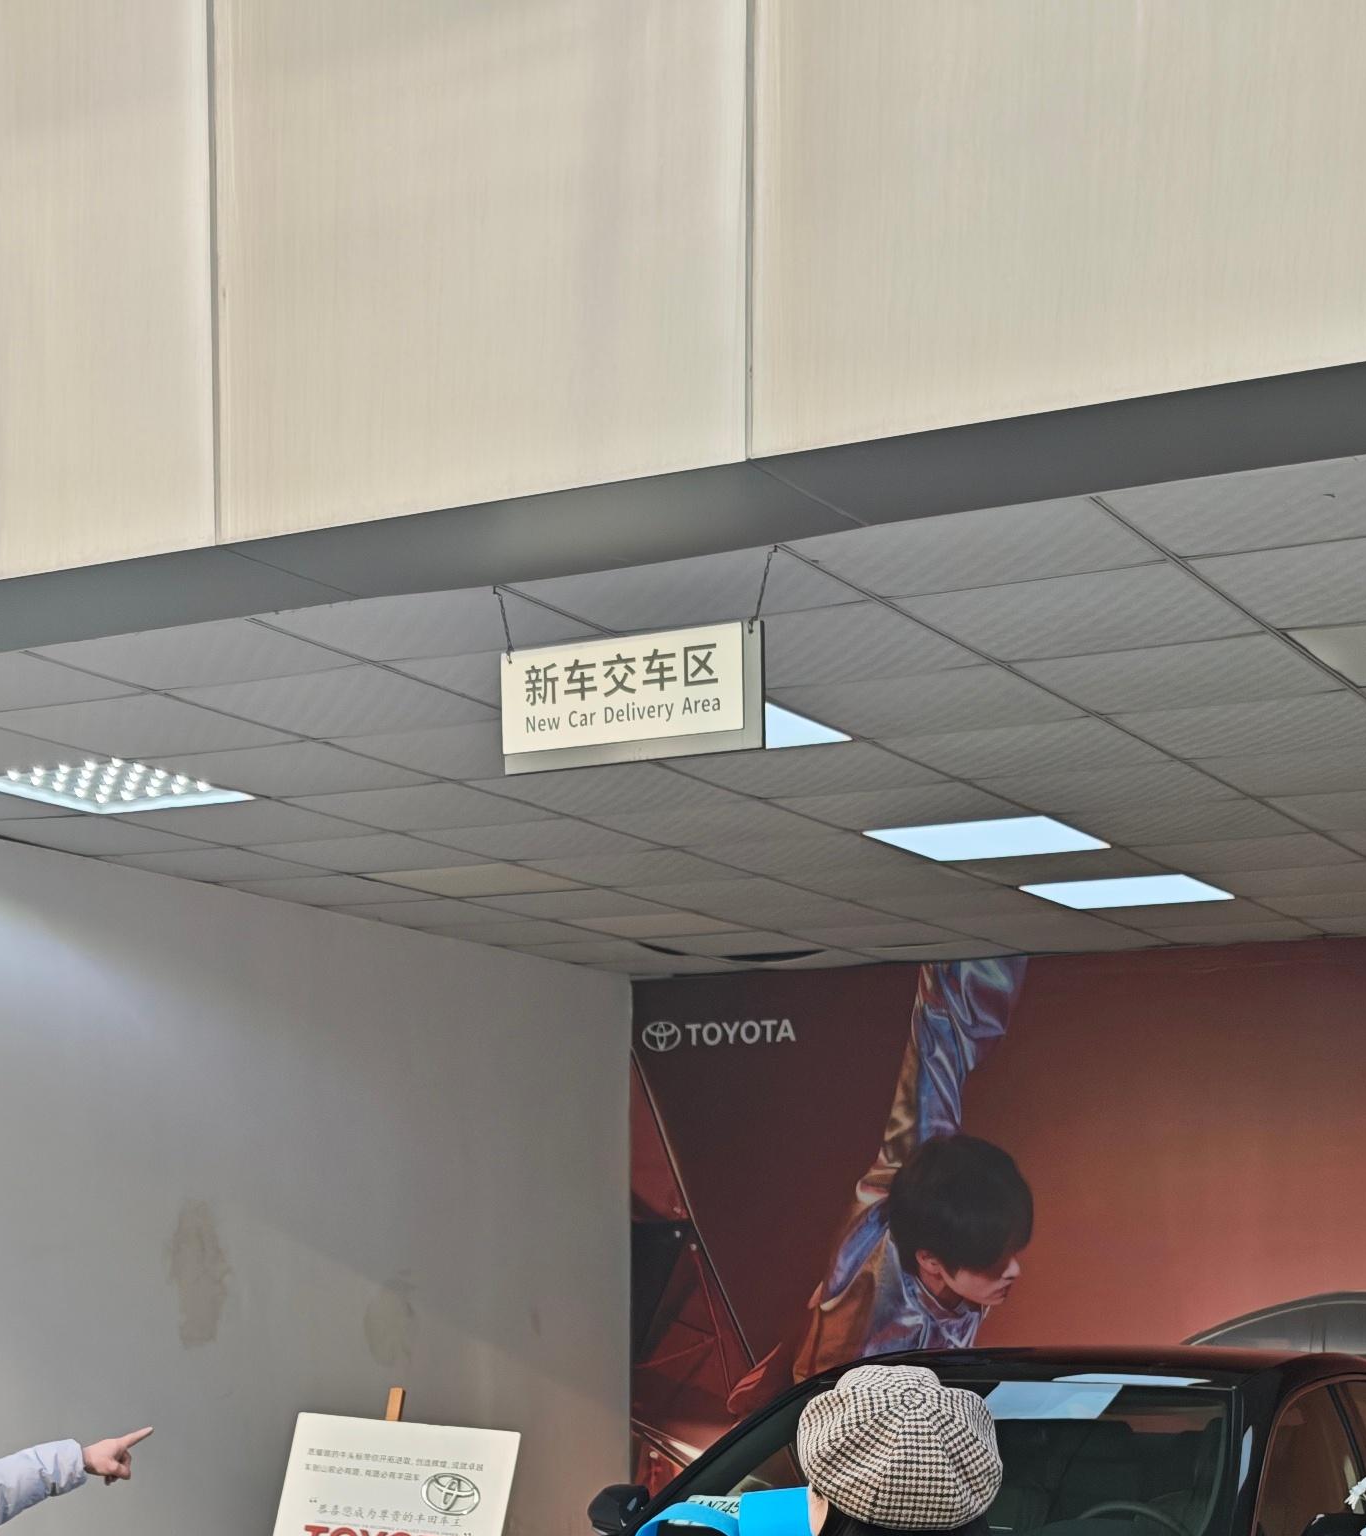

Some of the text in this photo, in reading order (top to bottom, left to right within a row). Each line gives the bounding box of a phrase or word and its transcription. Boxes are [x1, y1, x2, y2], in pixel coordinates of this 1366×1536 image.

[524, 643, 719, 706] 新车交车区
[525, 696, 721, 733] New Car Delivery Area
[685, 1018, 797, 1046] TOYOTA
